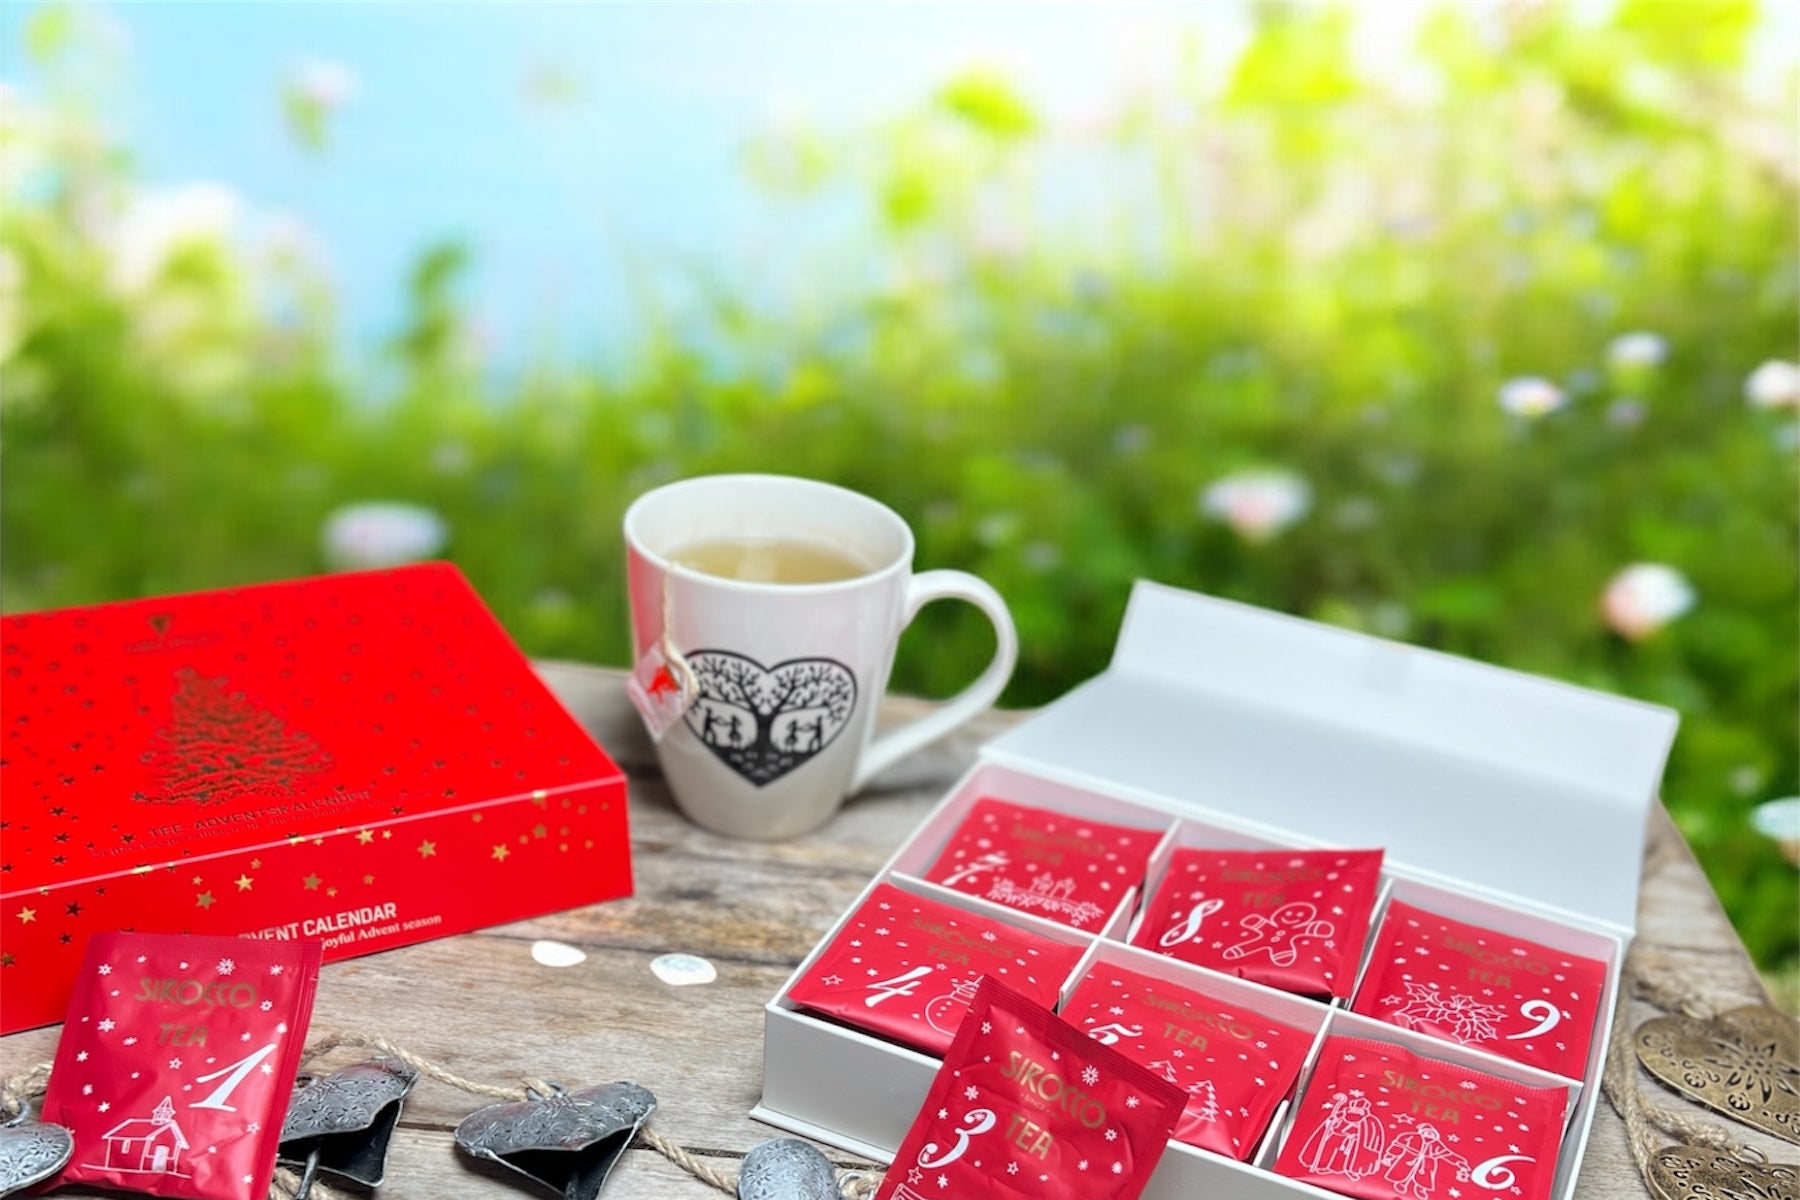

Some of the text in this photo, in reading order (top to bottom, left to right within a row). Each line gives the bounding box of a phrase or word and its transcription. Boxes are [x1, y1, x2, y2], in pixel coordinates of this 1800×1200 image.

[302, 902, 397, 937] CALENDAR
[357, 921, 401, 941] Advent
[401, 914, 443, 932] season
[927, 944, 971, 967] TEA
[134, 976, 257, 1009] SIROCCO
[864, 966, 933, 1008] 4
[1466, 966, 1511, 990] TEA
[158, 1022, 209, 1048] TEA
[1505, 999, 1561, 1040] 9
[1162, 1022, 1208, 1054] TEA
[188, 1043, 278, 1113] 1
[1000, 1050, 1107, 1129] SIROCCO
[1379, 1069, 1502, 1111] SIROCCO
[1409, 1099, 1460, 1125] TEA
[917, 1108, 997, 1169] 3
[1004, 1112, 1054, 1161] TEA
[1471, 1154, 1537, 1191] 6
